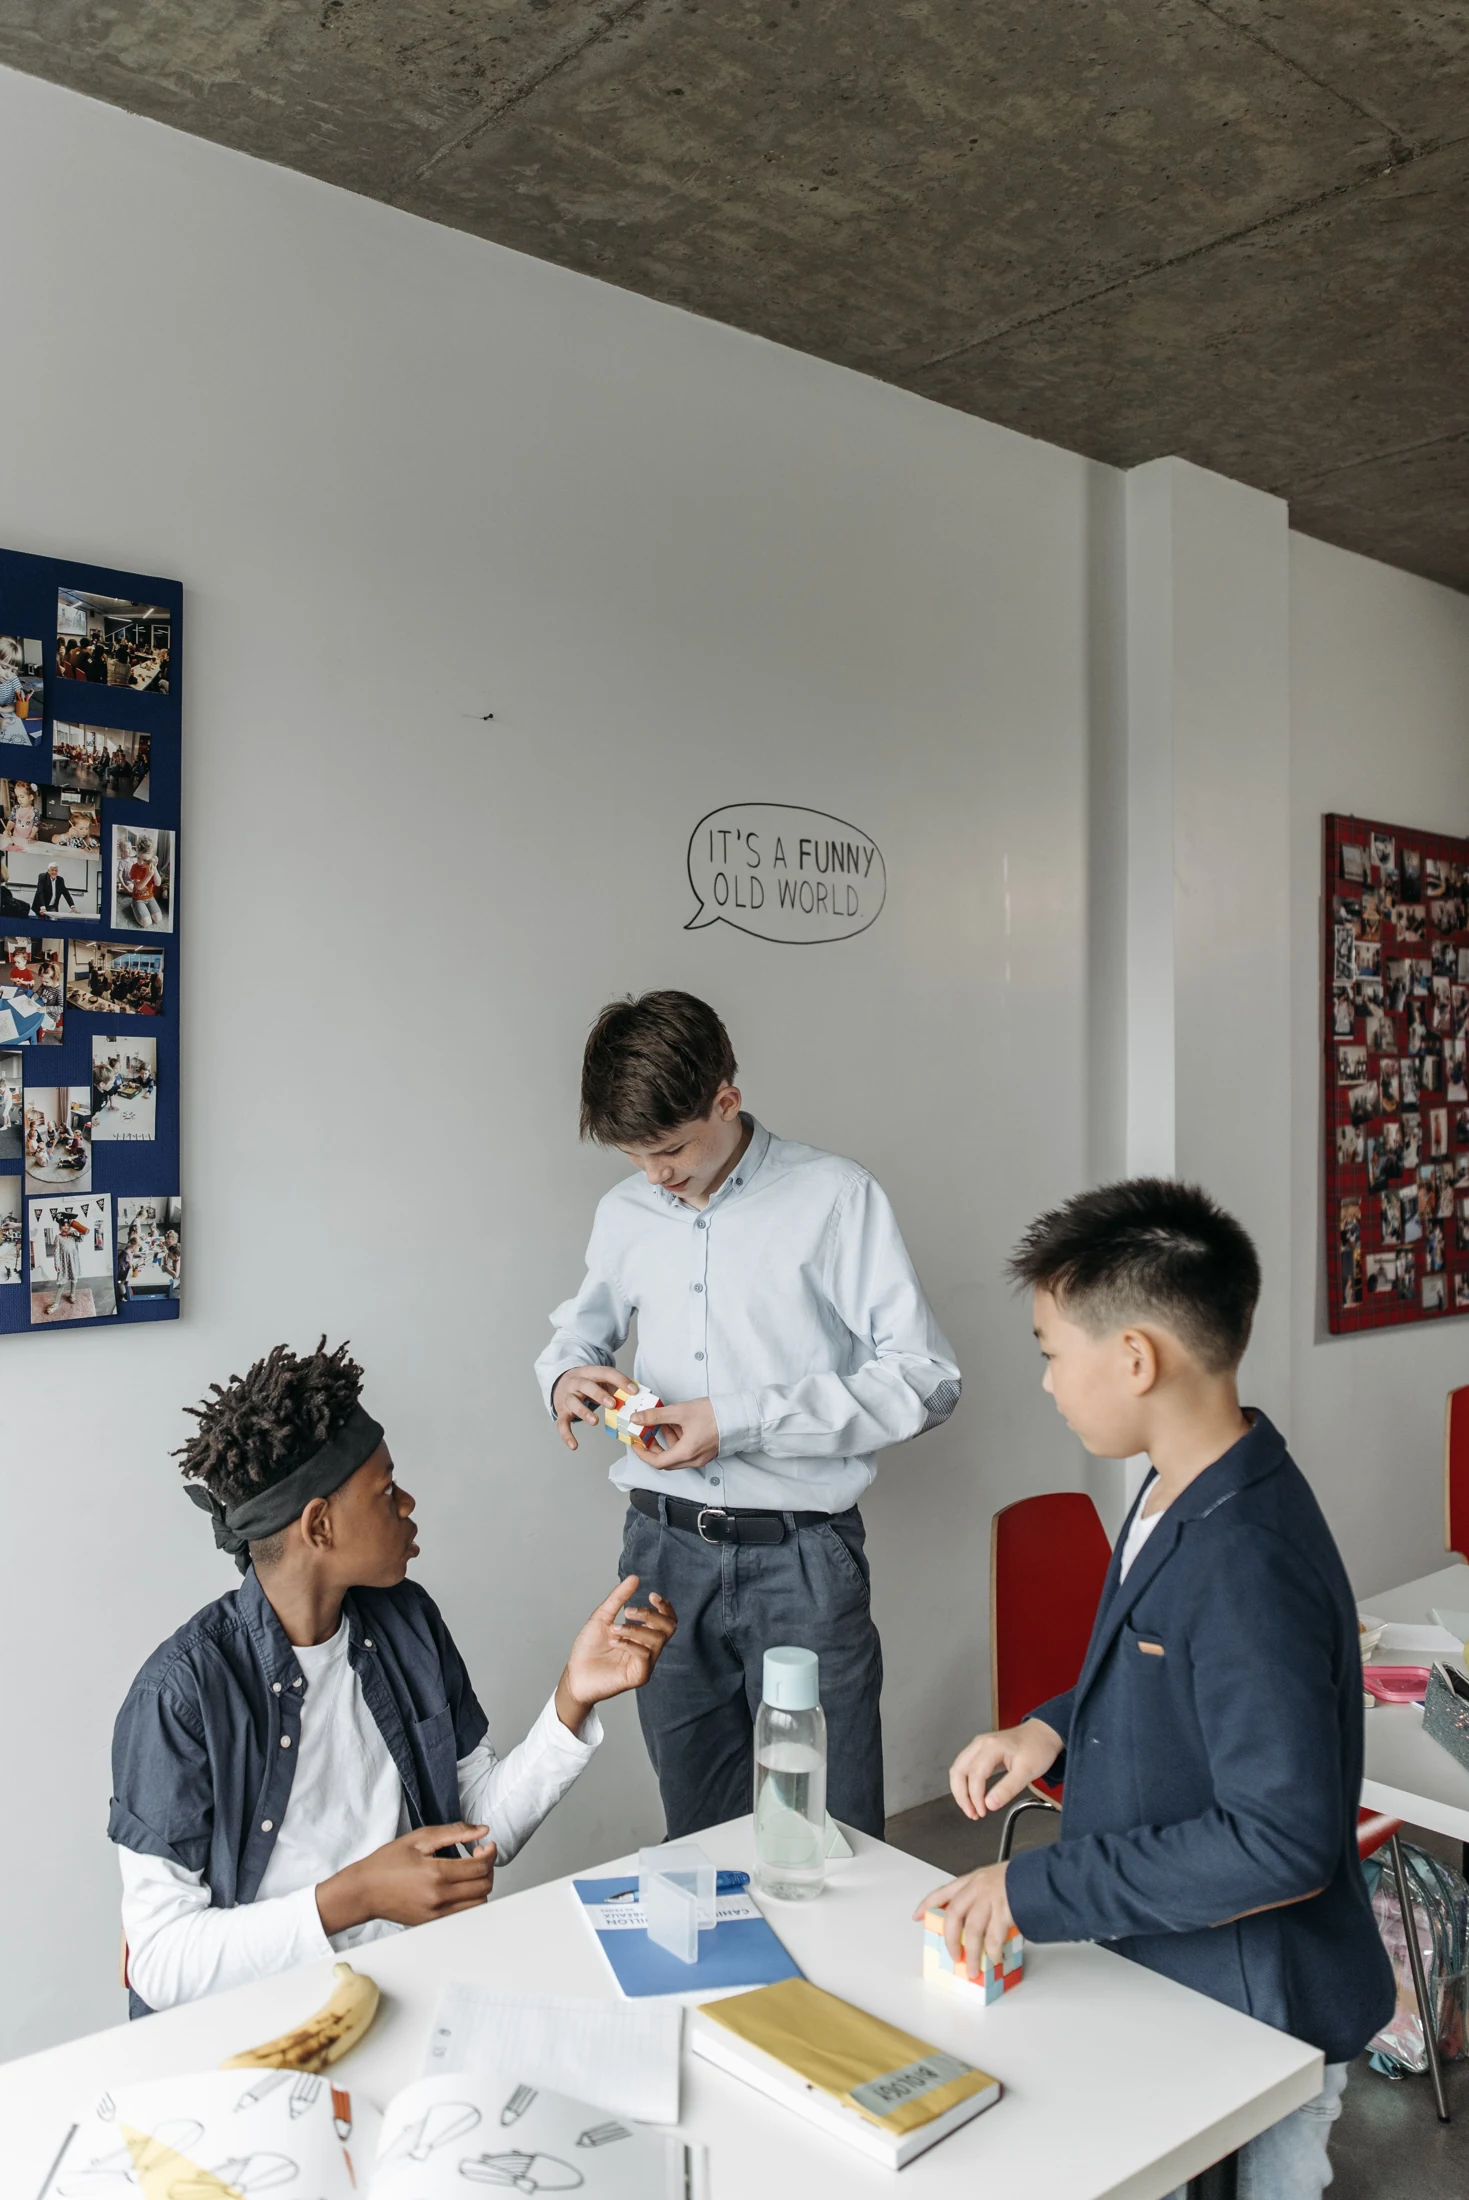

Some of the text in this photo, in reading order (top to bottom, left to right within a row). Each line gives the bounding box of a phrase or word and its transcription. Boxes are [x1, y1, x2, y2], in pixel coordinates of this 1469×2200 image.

[709, 828, 875, 878] IT'S A FUNNY
[713, 872, 764, 909] OLD
[606, 1918, 648, 1926] ILLON
